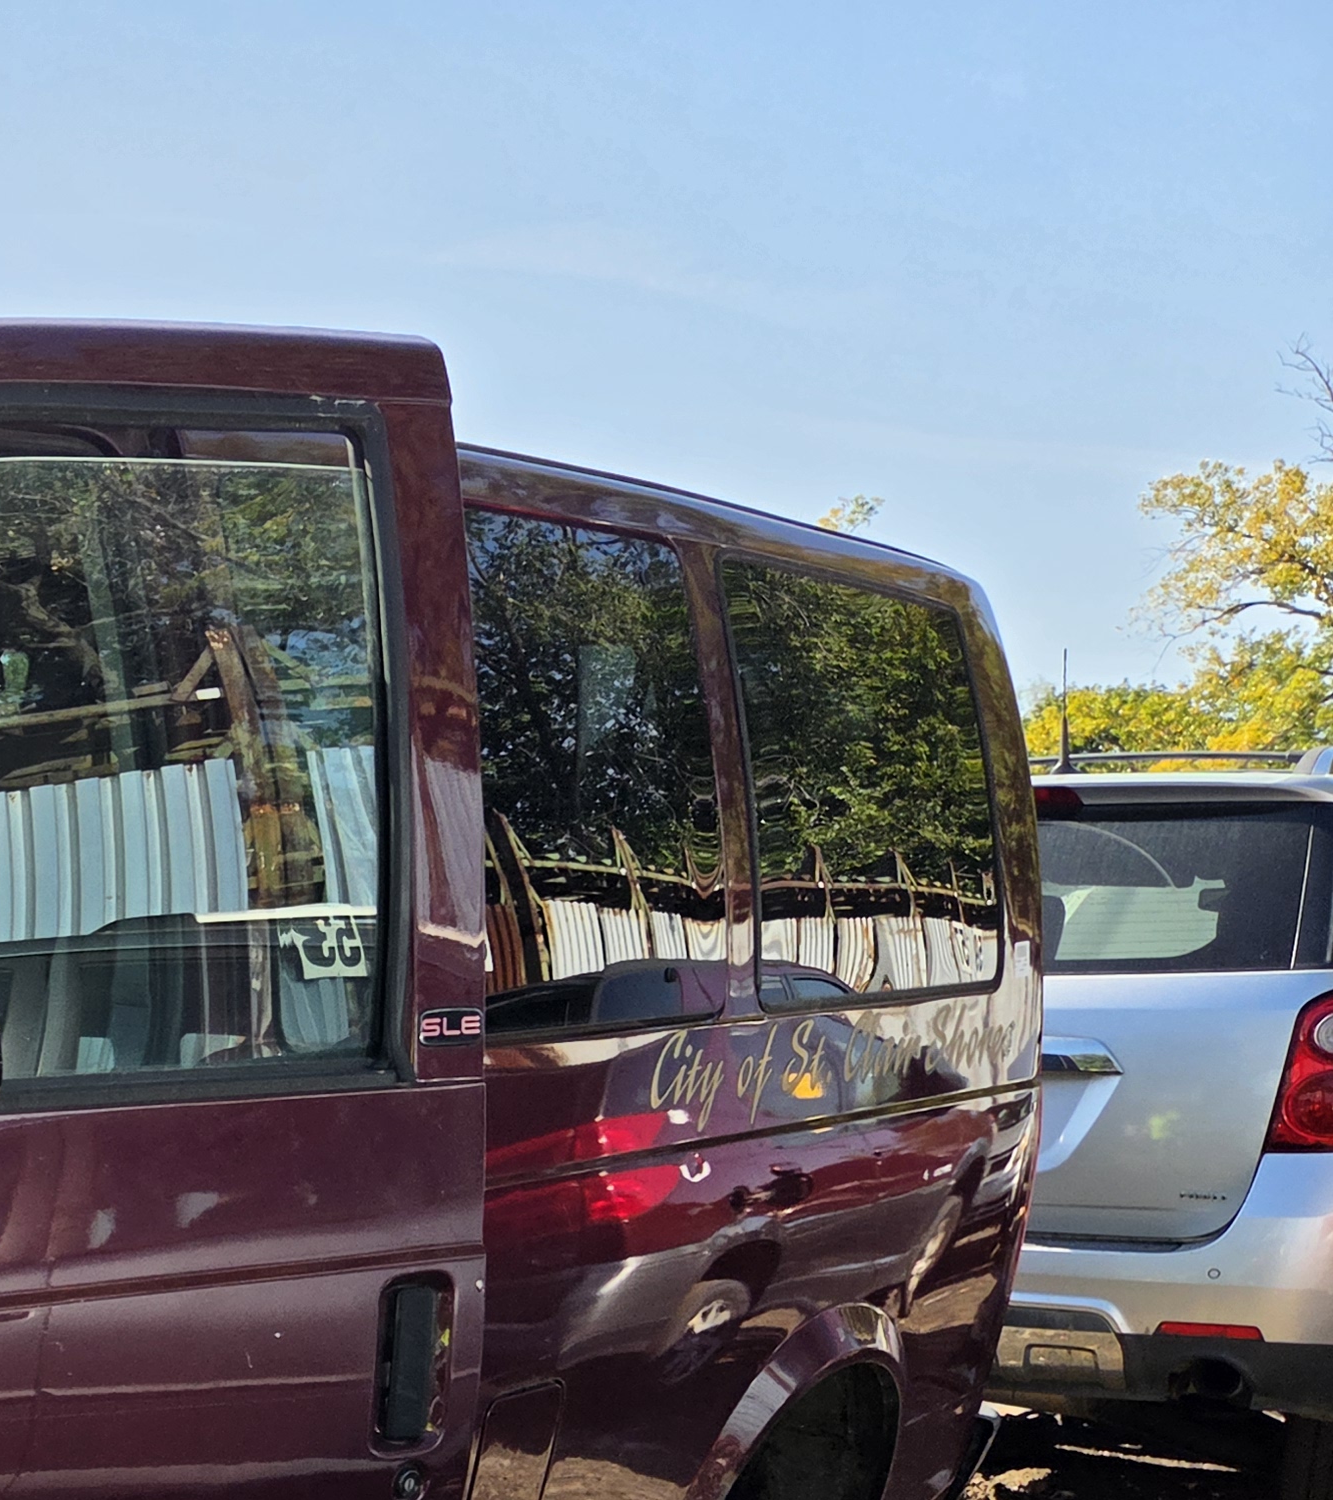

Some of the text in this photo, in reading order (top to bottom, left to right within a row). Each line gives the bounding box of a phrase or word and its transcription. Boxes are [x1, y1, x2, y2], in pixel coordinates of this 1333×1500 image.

[420, 1015, 481, 1037] SLE
[650, 1000, 1015, 1133] City of St. Clair Shores
